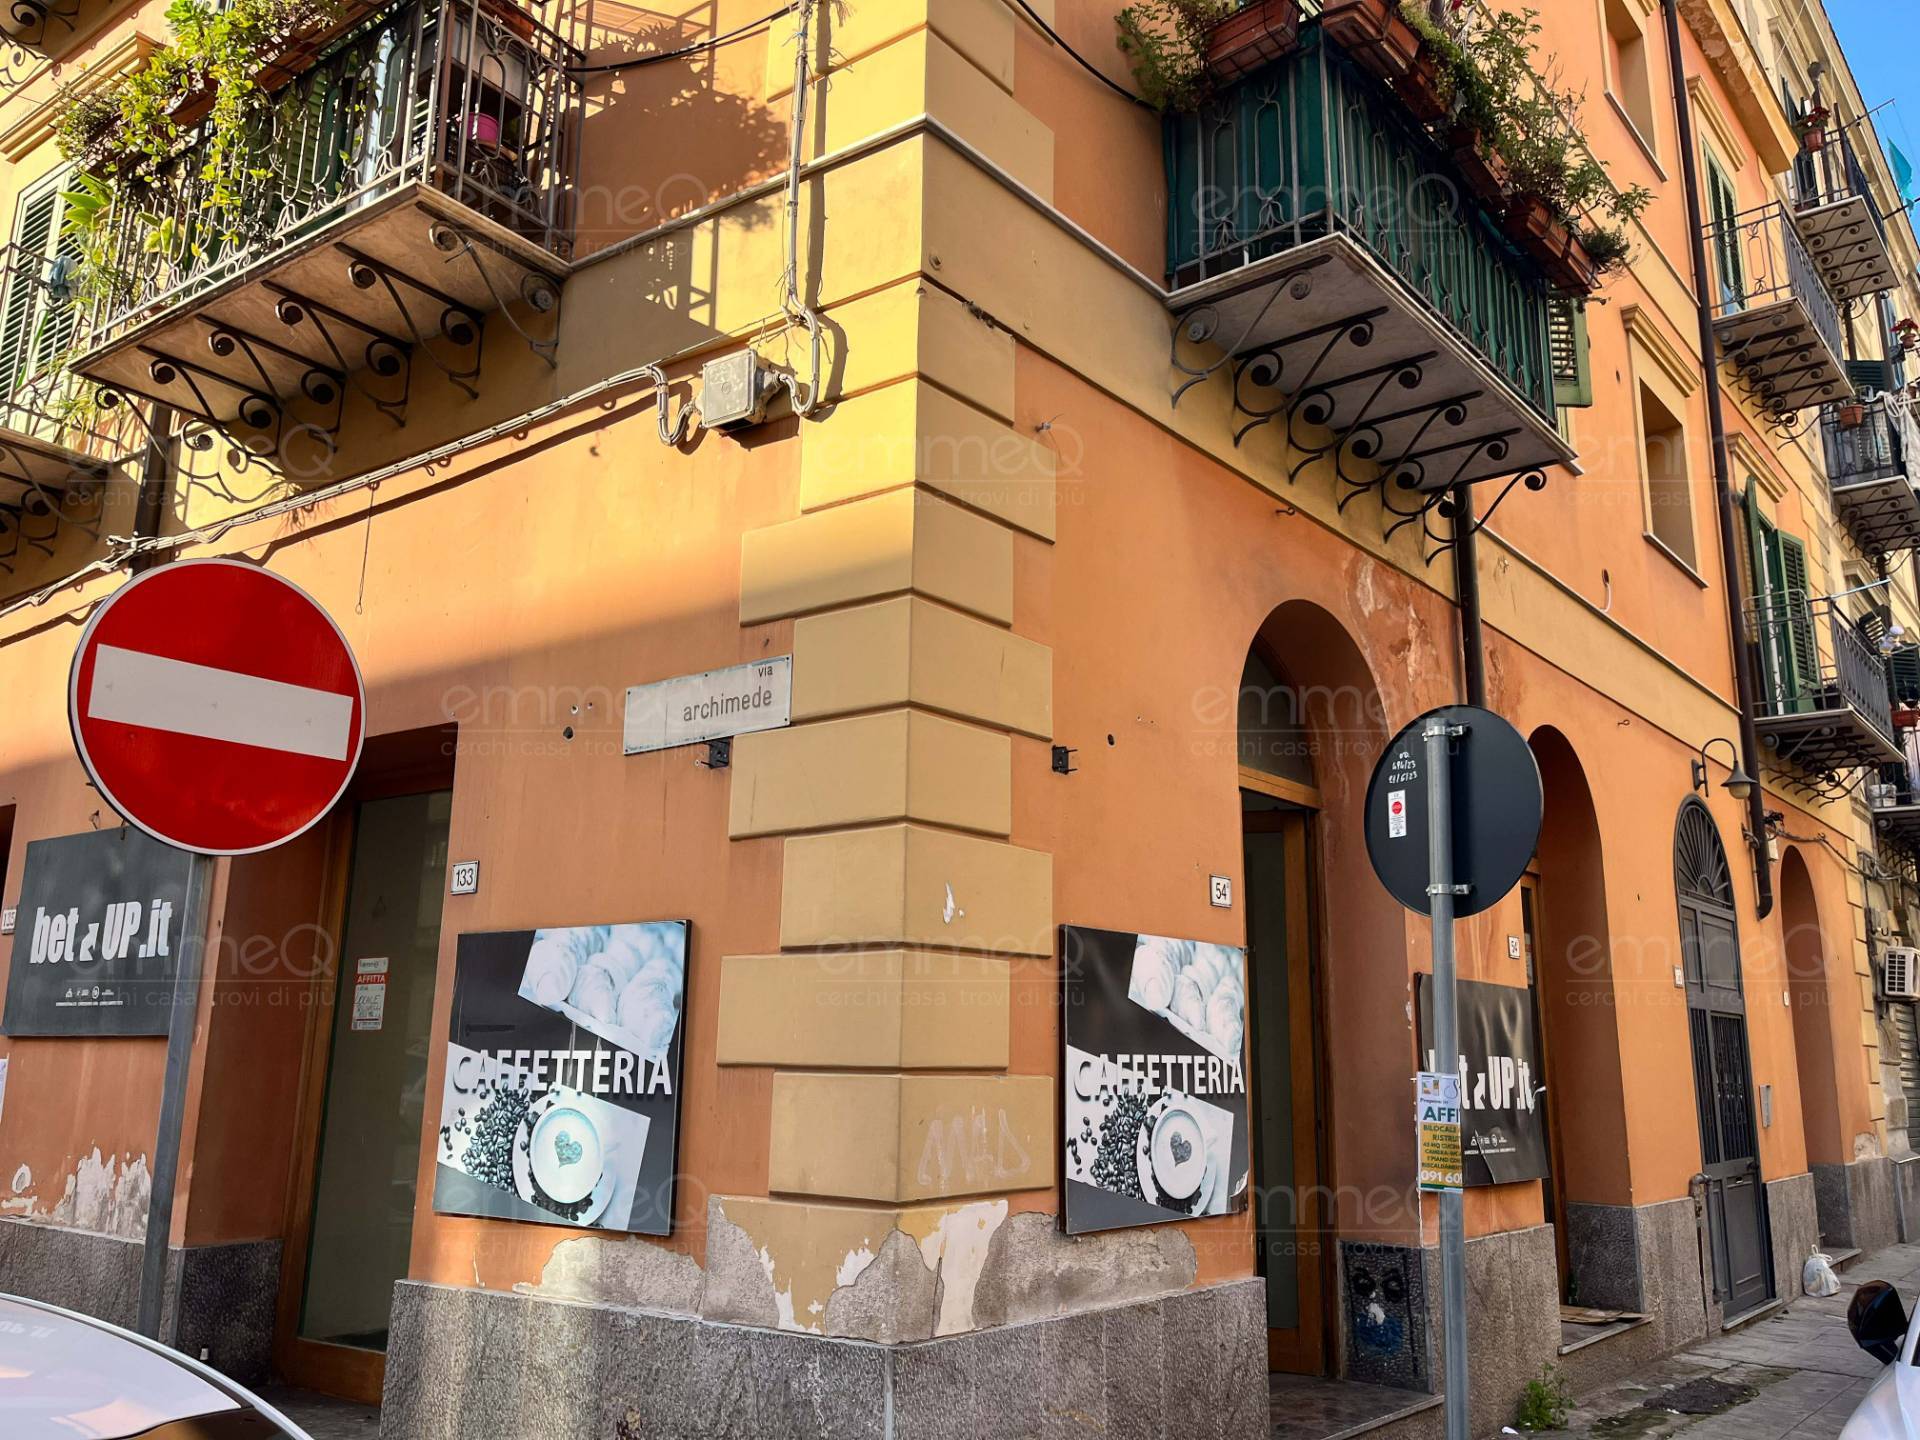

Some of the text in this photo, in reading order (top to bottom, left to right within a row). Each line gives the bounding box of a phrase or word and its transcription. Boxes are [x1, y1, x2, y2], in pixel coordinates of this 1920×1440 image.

[758, 665, 773, 678] via
[683, 685, 772, 721] archimede
[456, 868, 474, 887] 133
[1215, 882, 1227, 900] 54
[30, 906, 79, 964] bet
[357, 974, 386, 984] AFFITTA
[452, 1049, 673, 1095] CAFFETTERIA
[1074, 1054, 1246, 1101] CAFFETTERIA
[1421, 1170, 1442, 1182] 091
